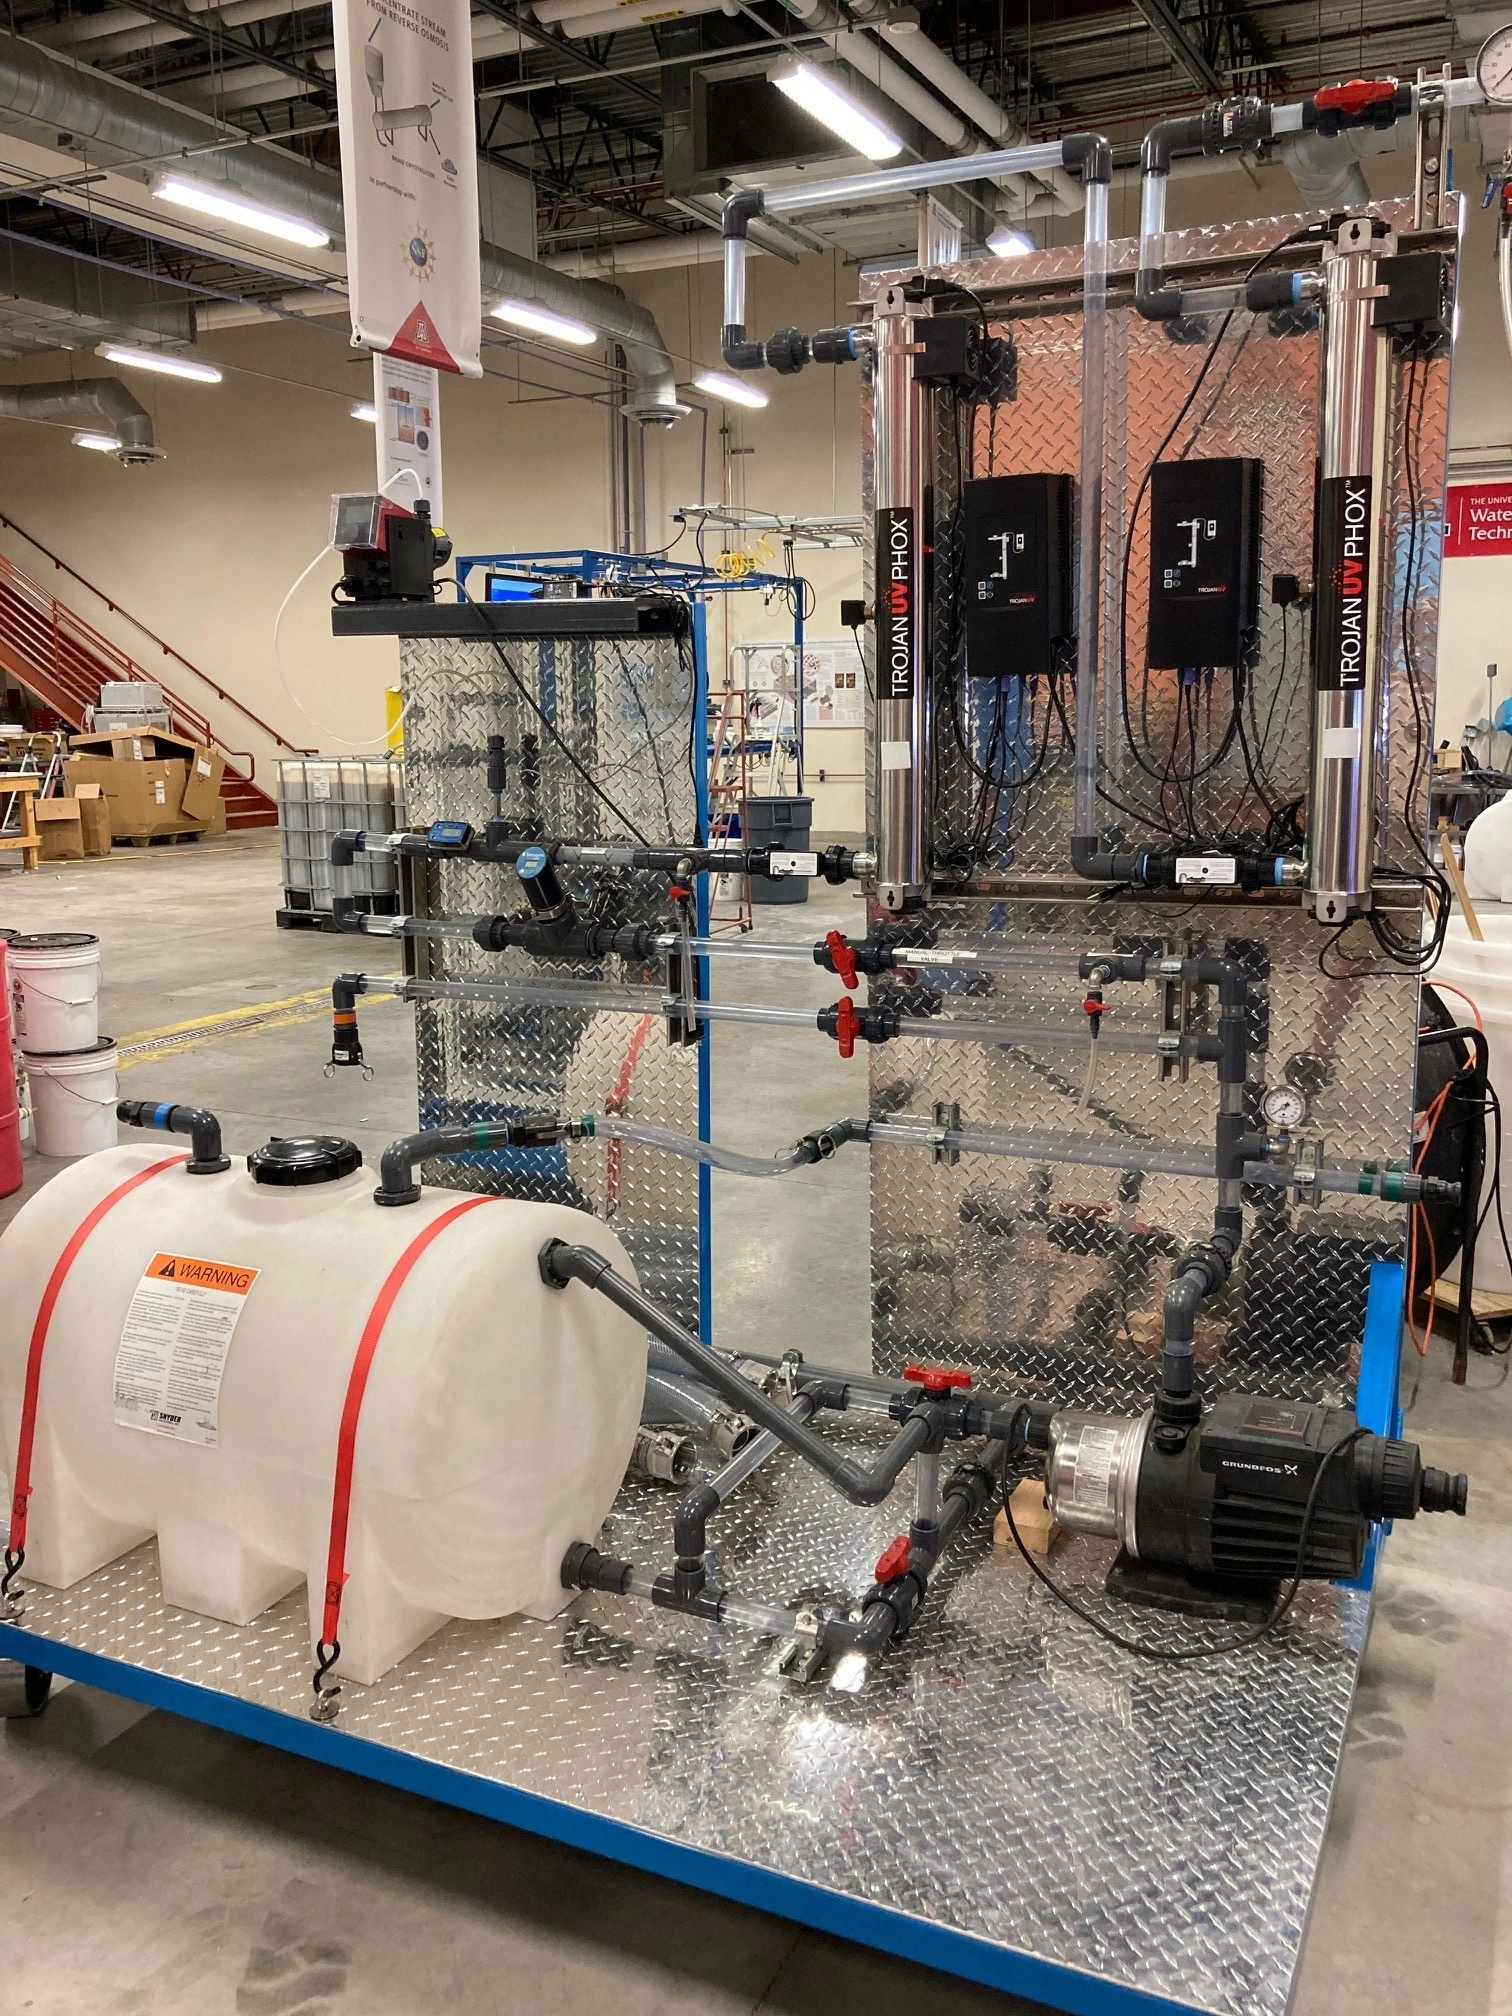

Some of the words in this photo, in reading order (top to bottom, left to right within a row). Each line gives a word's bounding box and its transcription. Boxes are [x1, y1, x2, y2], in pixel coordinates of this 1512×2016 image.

[366, 0, 387, 16] FROM
[389, 9, 419, 34] REVERSE
[420, 27, 449, 52] OSMOSIS
[381, 0, 419, 21] CENTRATE
[420, 15, 447, 38] STREAM
[410, 244, 427, 260] NSF
[1470, 497, 1486, 505] THE
[1469, 508, 1512, 523] Wate
[179, 1262, 250, 1289] WARNING
[158, 1411, 182, 1424] SNYDER
[1221, 1460, 1282, 1474] GRUNDFOS
